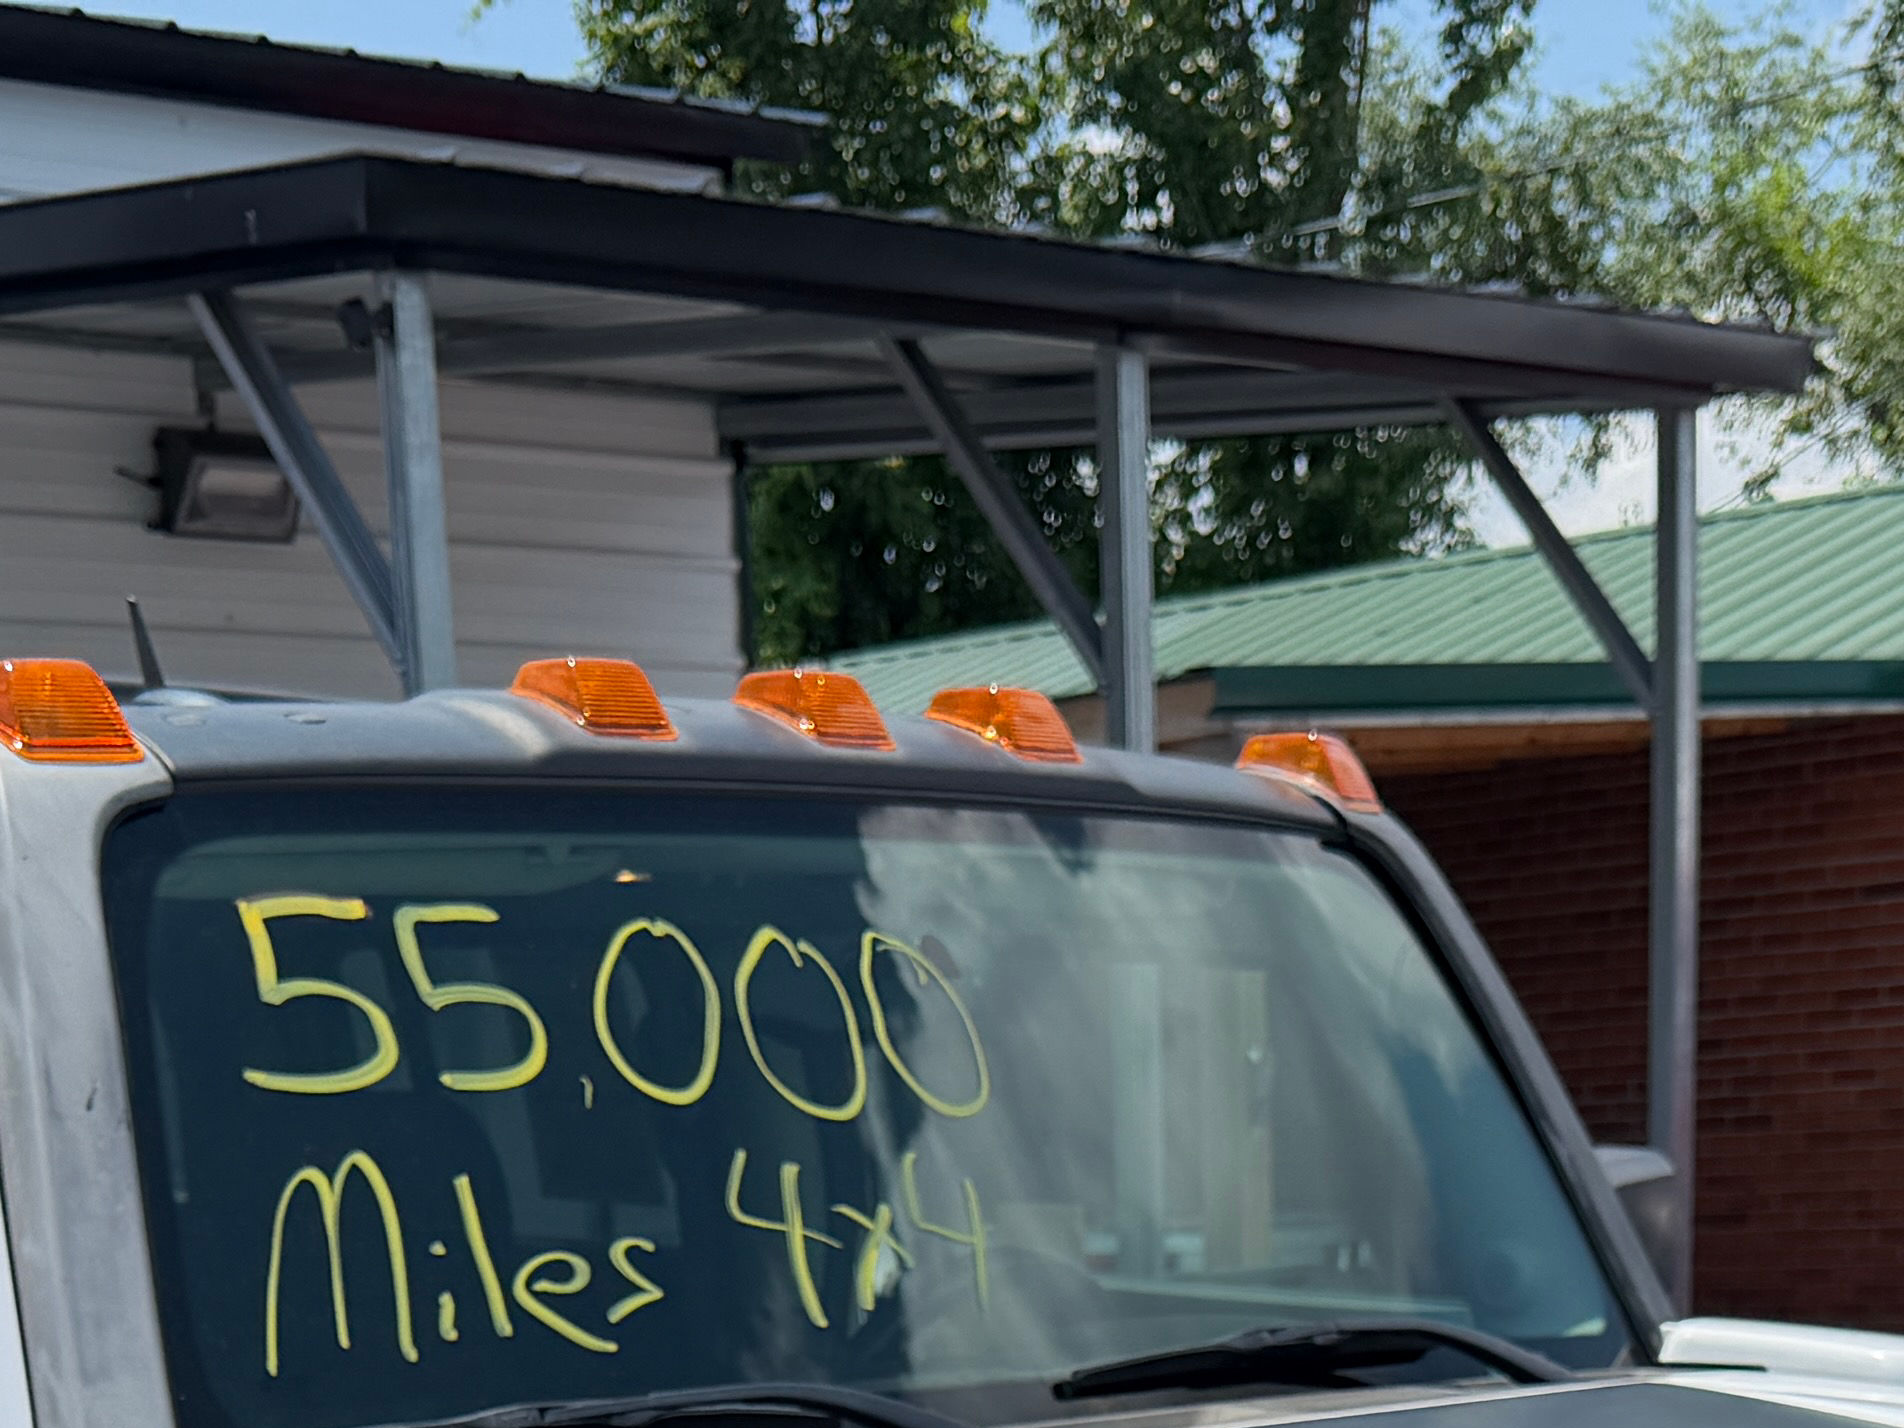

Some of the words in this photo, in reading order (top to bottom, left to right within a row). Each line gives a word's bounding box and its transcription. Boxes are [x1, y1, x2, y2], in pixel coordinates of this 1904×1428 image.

[235, 891, 991, 1121] 55,000
[263, 1149, 665, 1377] Miles
[725, 1147, 993, 1329] 4x4
